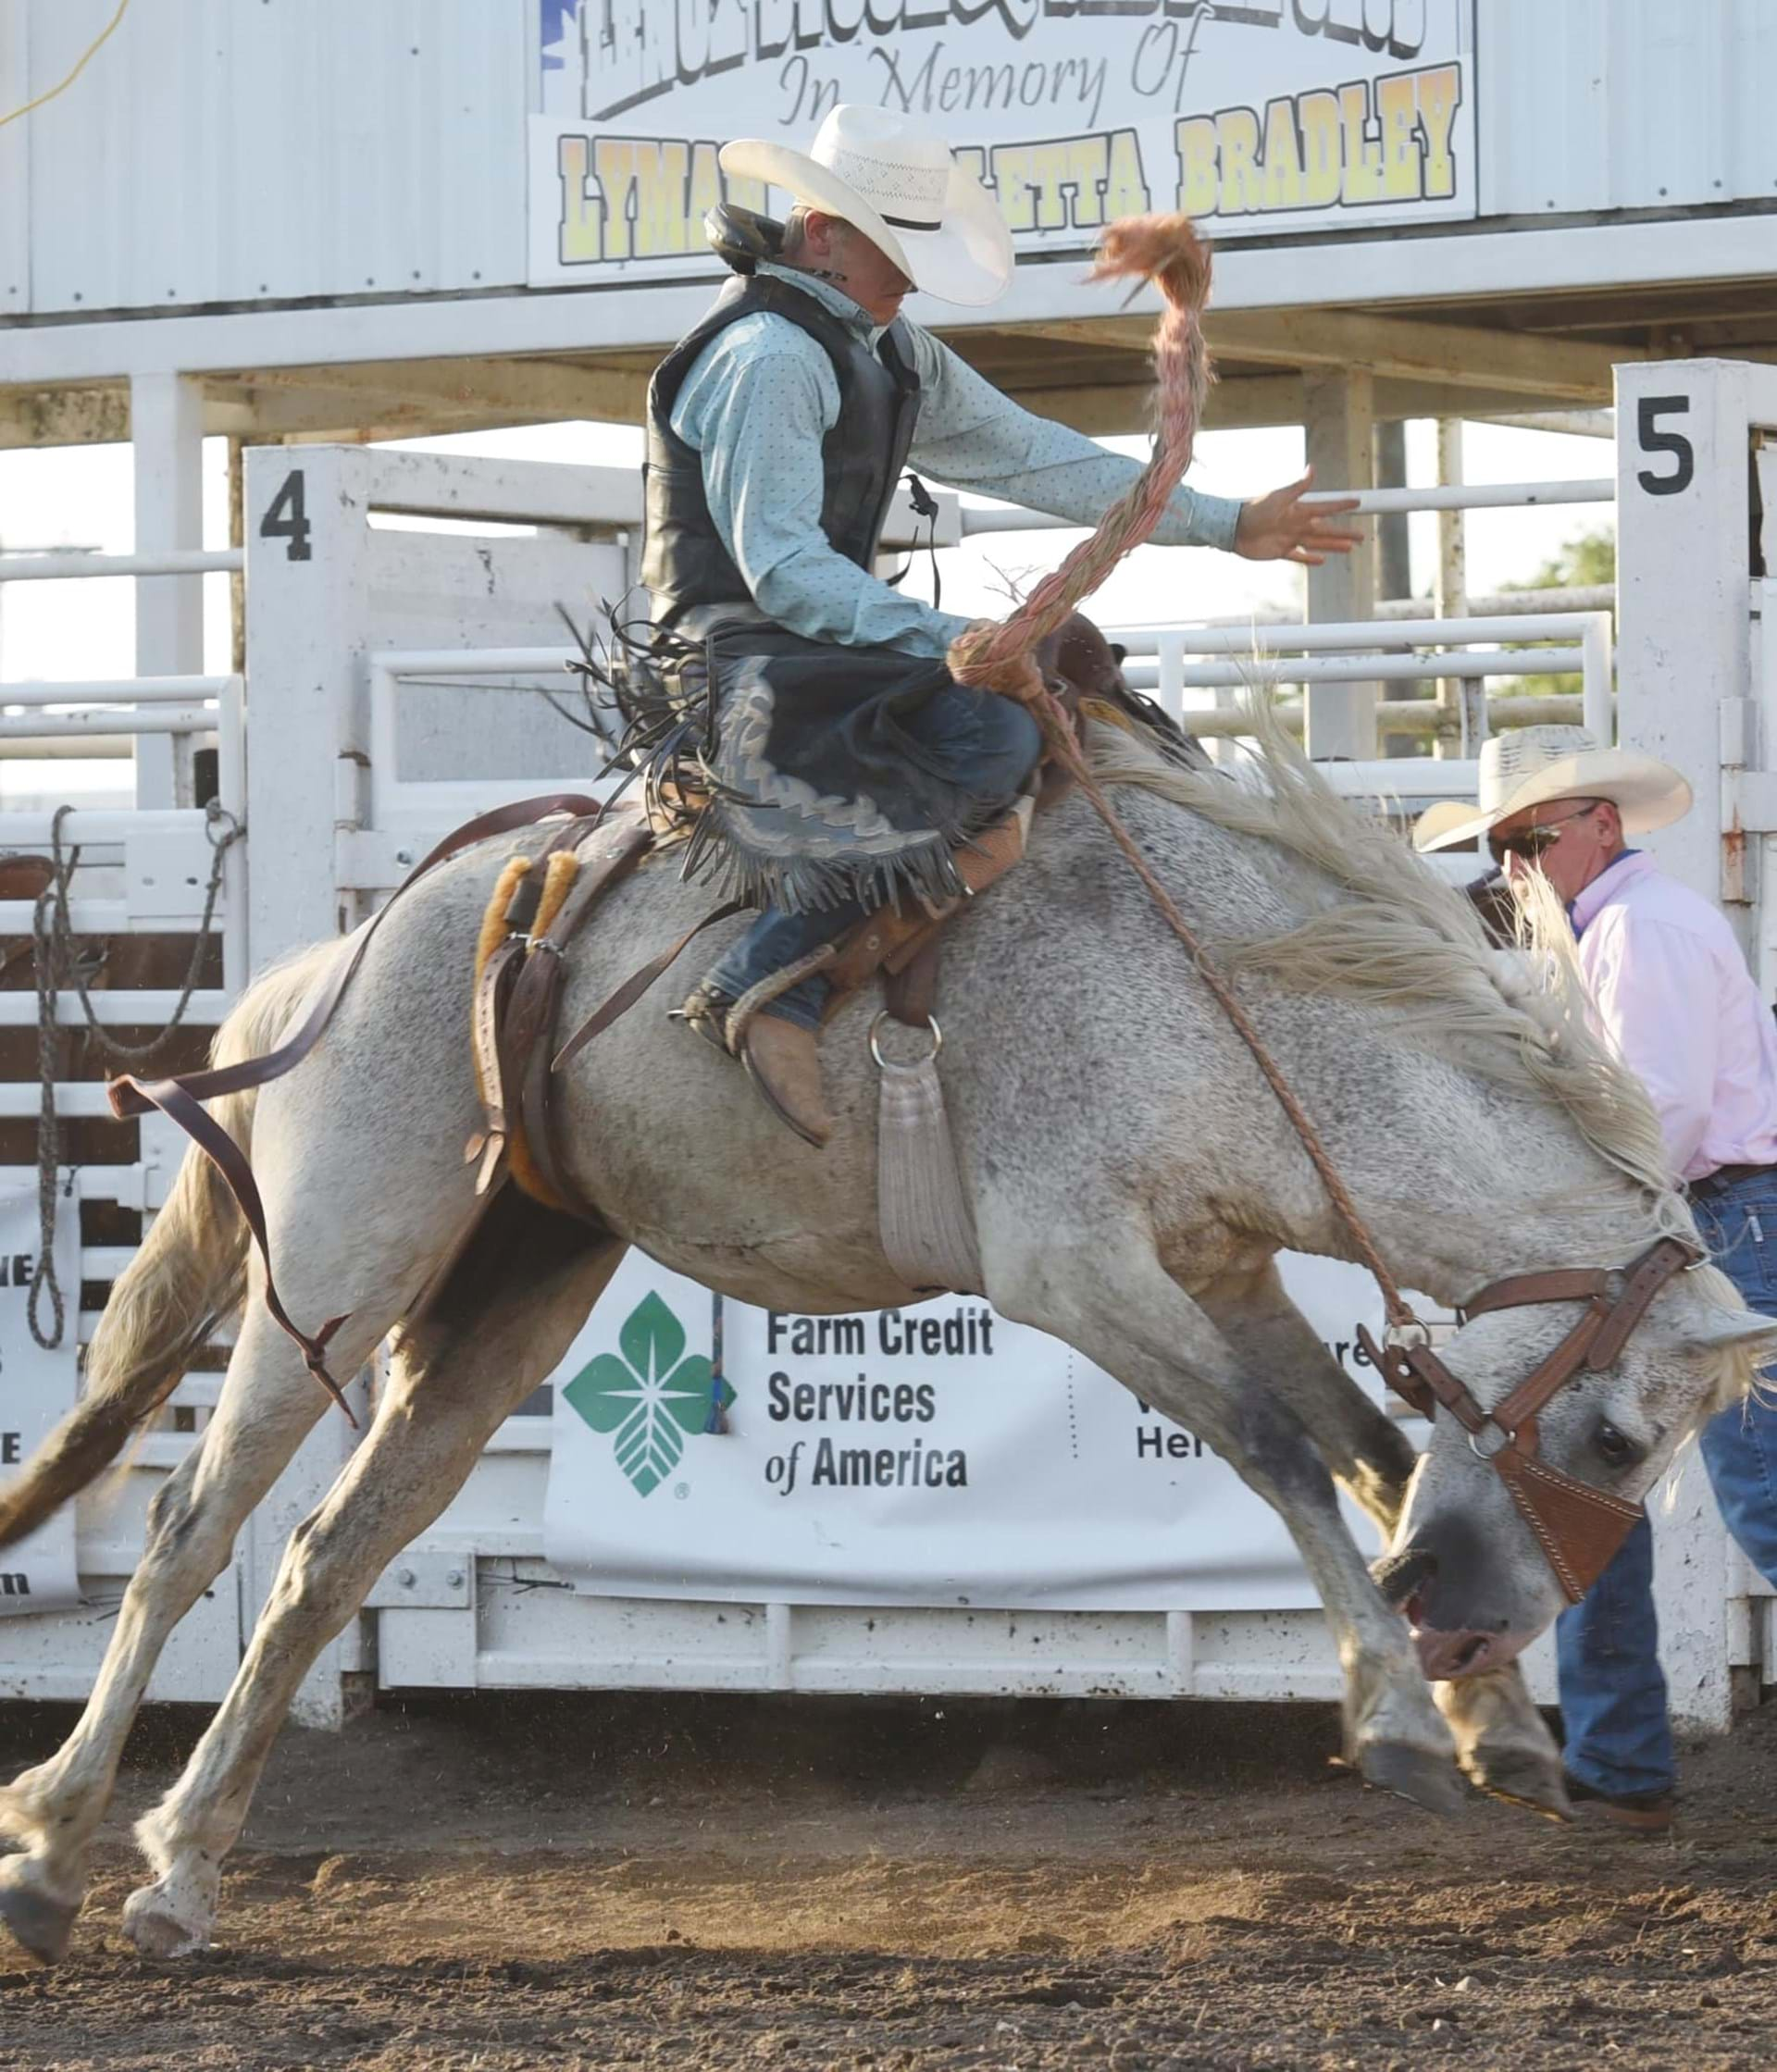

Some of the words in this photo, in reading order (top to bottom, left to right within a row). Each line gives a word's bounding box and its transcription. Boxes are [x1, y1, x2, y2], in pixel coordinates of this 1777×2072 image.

[778, 56, 839, 125] In
[868, 42, 1107, 128] Memory
[1131, 4, 1216, 113] Of
[950, 128, 1151, 233] ETTA
[1174, 61, 1461, 218] BRADLEY
[1637, 395, 1693, 495] 5
[260, 469, 311, 561] 4
[767, 1311, 865, 1355] Farm
[878, 1308, 993, 1355] Credit
[768, 1371, 936, 1422] Services
[765, 1441, 806, 1496] of
[812, 1437, 968, 1487] America
